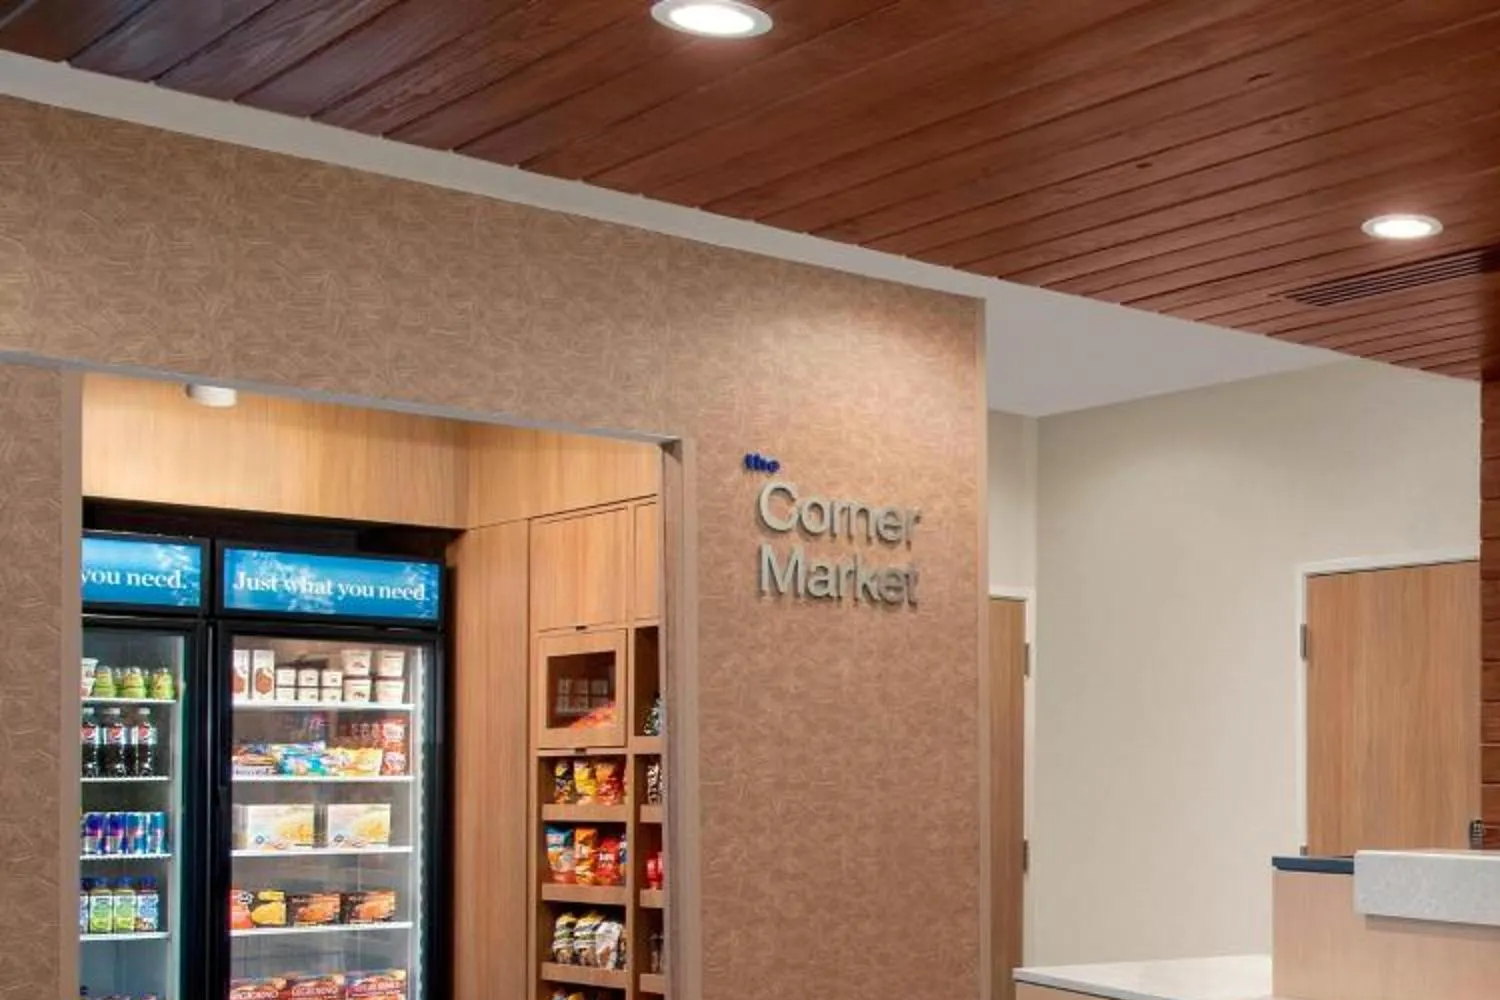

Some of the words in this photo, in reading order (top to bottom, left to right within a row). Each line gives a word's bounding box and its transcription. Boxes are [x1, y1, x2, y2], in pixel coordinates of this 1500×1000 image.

[744, 453, 780, 473] the
[757, 481, 921, 550] Corner
[126, 570, 188, 589] need.
[233, 571, 281, 593] Just
[284, 574, 333, 596] what
[336, 582, 375, 601] you
[758, 543, 919, 608] Market
